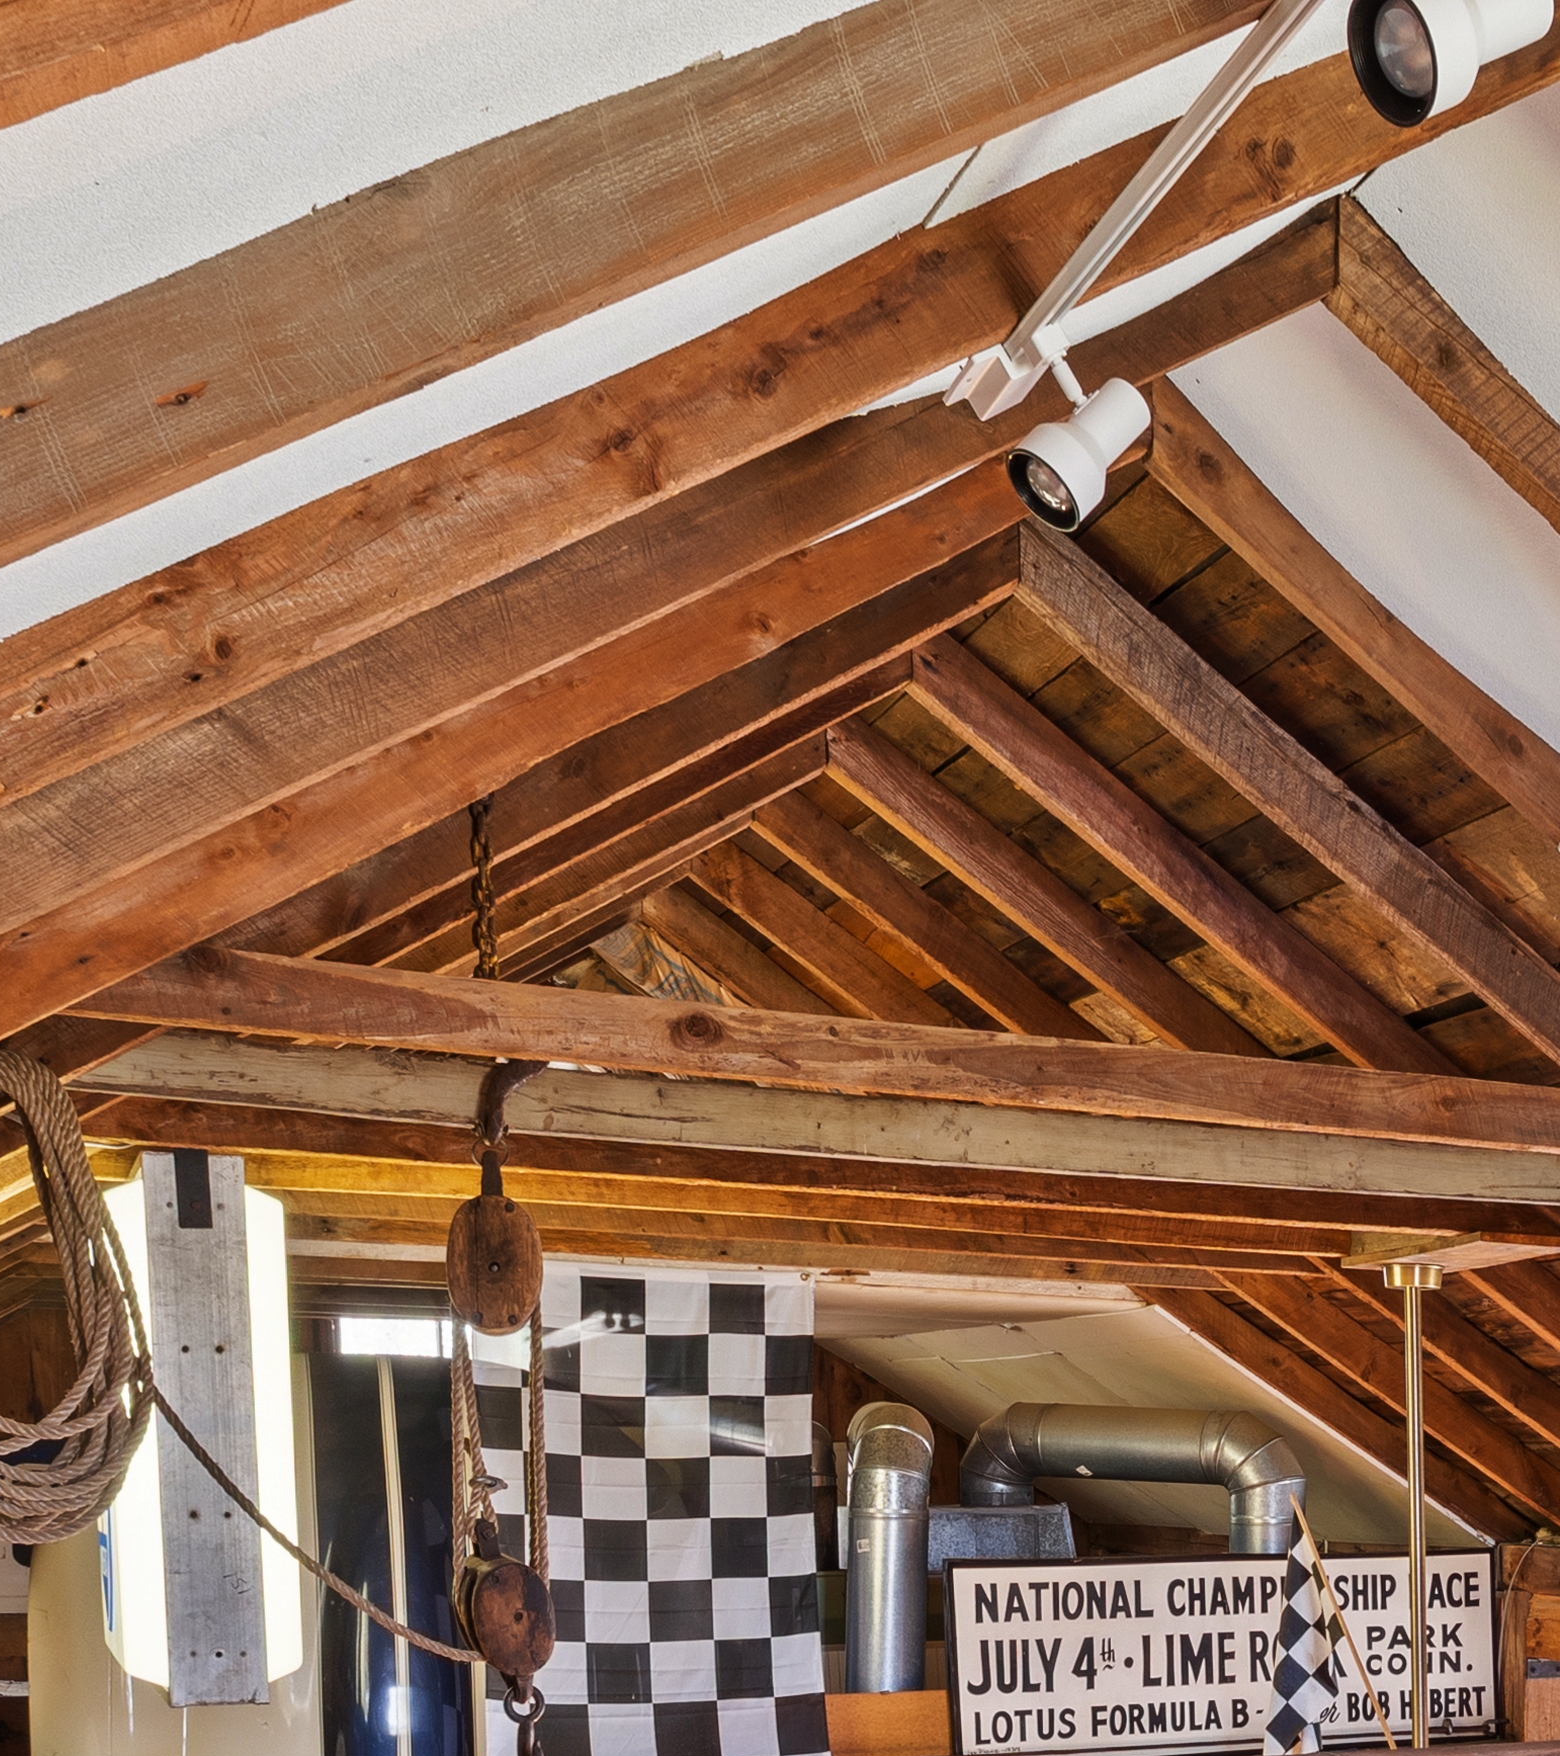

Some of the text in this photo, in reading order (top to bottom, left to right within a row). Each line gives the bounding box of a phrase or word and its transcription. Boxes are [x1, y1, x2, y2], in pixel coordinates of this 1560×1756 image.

[974, 1571, 1481, 1624] NATIONAL CHAMPSHIP ACE
[967, 1637, 1062, 1696] JULY
[1072, 1635, 1117, 1691] 4th
[1140, 1631, 1236, 1688] LIME
[1365, 1650, 1474, 1676] CON.
[975, 1705, 1077, 1746] LOTUS
[1091, 1699, 1223, 1740] FORMULA
[1347, 1690, 1391, 1723] BOB
[1400, 1685, 1487, 1720] HBERT
